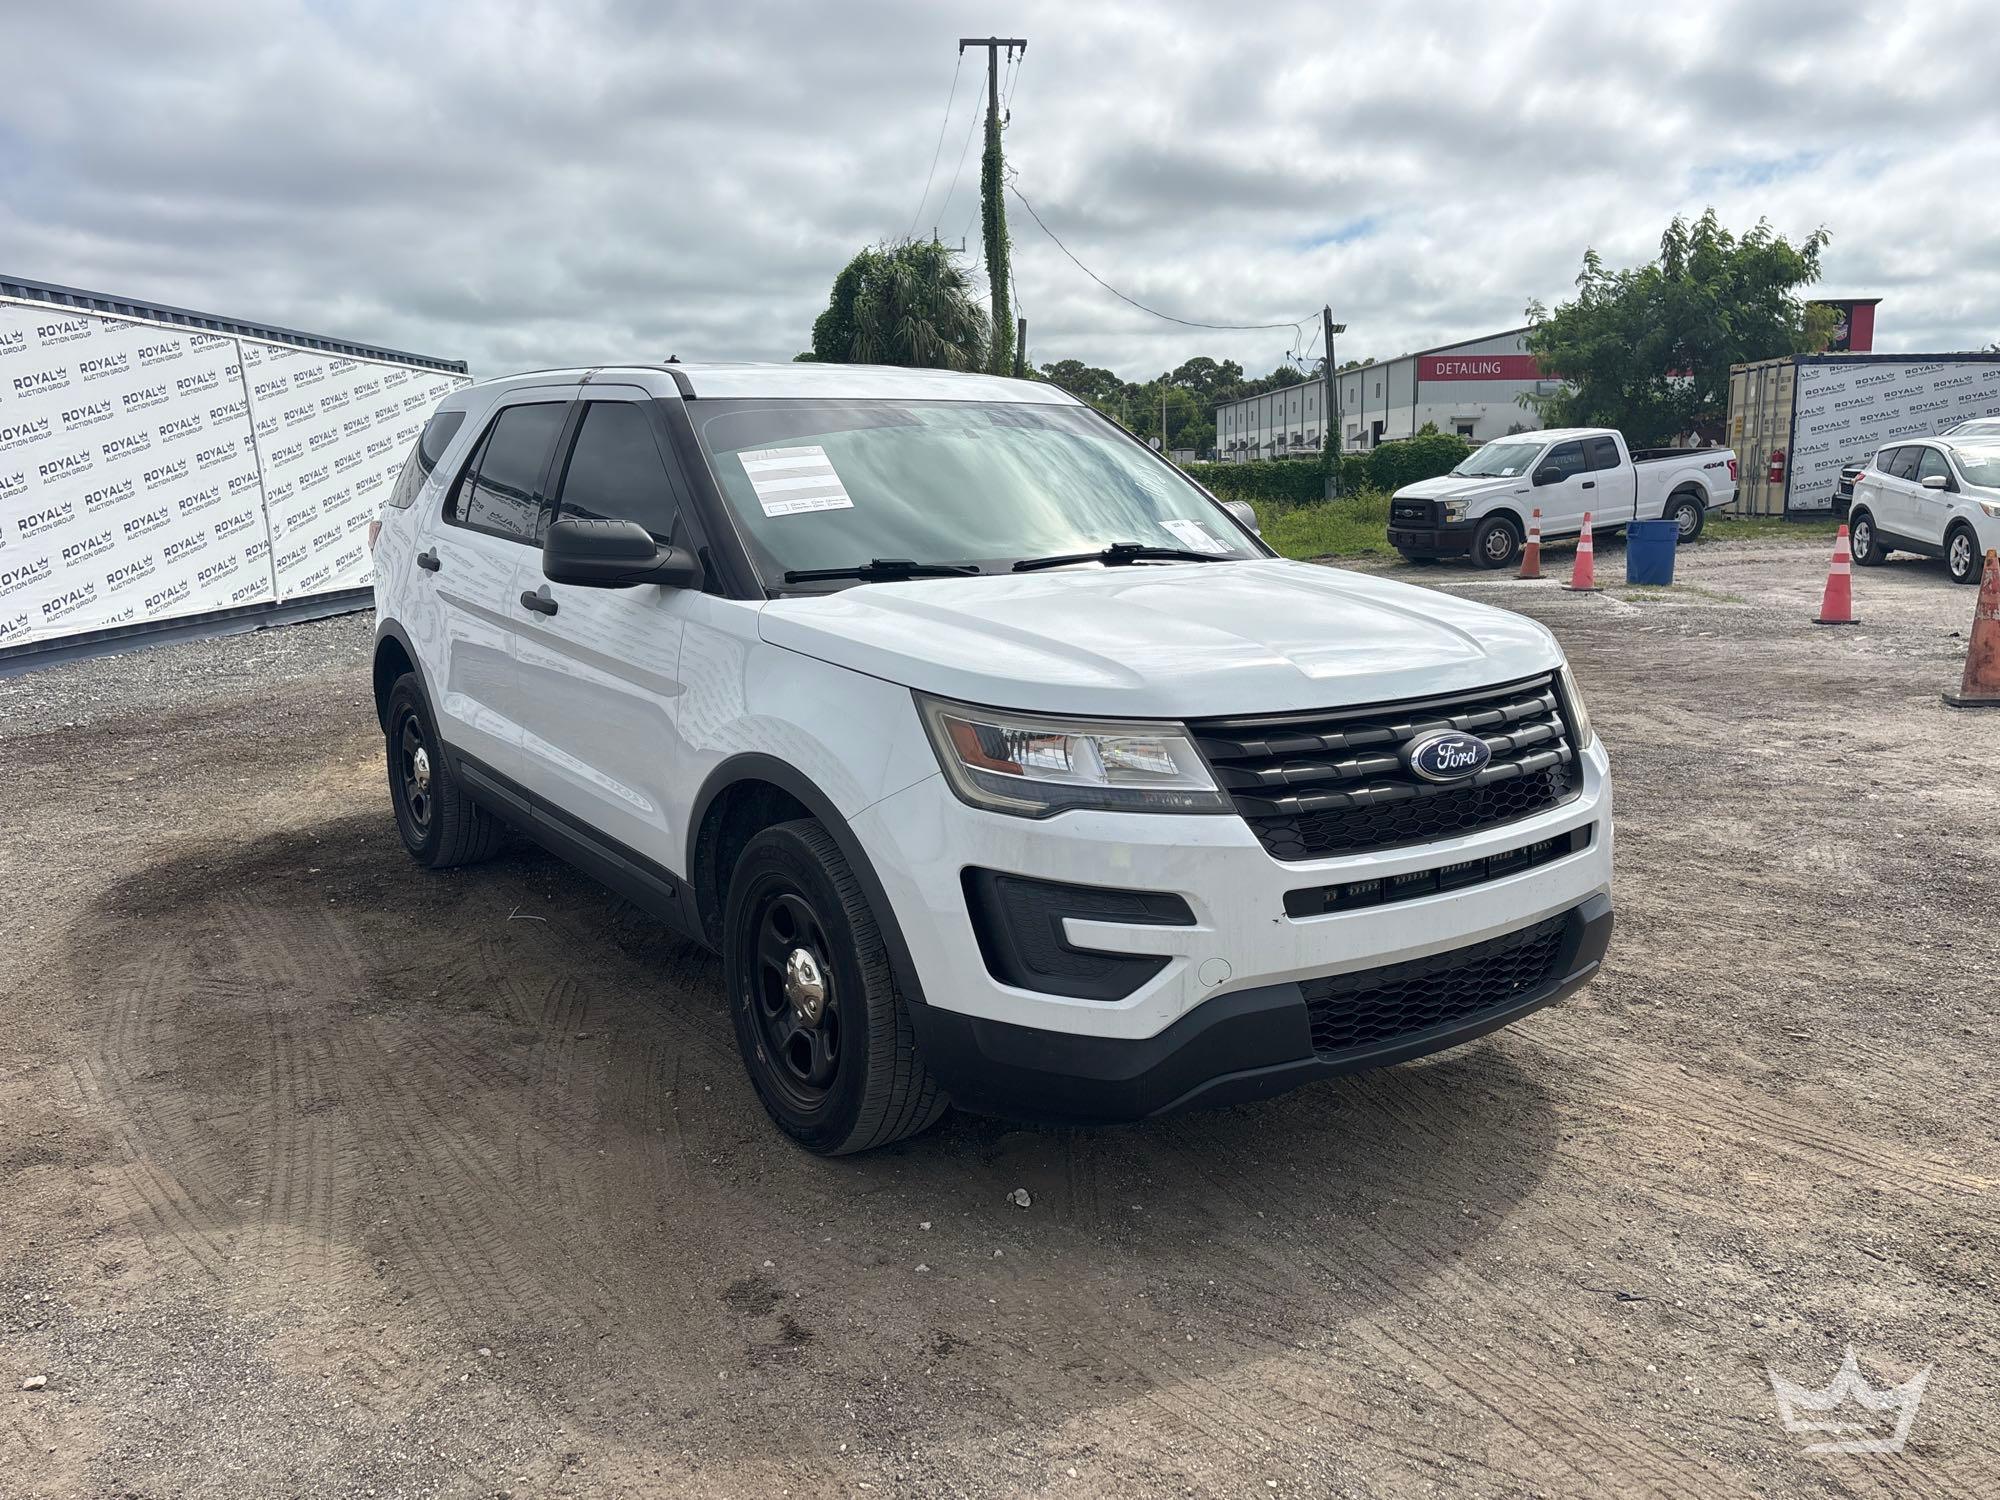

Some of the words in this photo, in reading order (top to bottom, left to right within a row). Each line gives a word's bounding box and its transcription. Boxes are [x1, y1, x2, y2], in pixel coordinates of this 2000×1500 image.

[37, 321, 80, 338] ROYAL
[105, 323, 129, 333] AUCTION
[41, 335, 71, 346] AUCTION
[70, 331, 92, 340] GROUP
[194, 344, 216, 353] AUCTION
[215, 339, 231, 348] GROUP
[3, 344, 27, 356] GROUP
[138, 342, 173, 359] ROYAL
[142, 356, 166, 366] AUCTION
[165, 351, 182, 360] GROUP
[79, 356, 119, 373] ROYAL
[84, 370, 111, 381] AUCTION
[110, 365, 130, 375] GROUP
[329, 358, 351, 371] ROYAL
[1436, 362, 1501, 375] DETAILING
[1905, 364, 1936, 374] ROYAL
[13, 370, 58, 390] ROYAL
[177, 373, 210, 390] ROYAL
[293, 368, 318, 382] ROYAL
[384, 371, 403, 384] ROYAL
[1856, 375, 1887, 385] ROYAL
[1933, 377, 1965, 388] ROYAL
[18, 386, 48, 398] AUCTION
[48, 380, 70, 390] GROUP
[180, 386, 203, 397] AUCTION
[202, 381, 218, 391] GROUP
[254, 379, 282, 394] ROYAL
[354, 382, 374, 395] ROYAL
[429, 384, 445, 396] ROYAL
[1806, 385, 1837, 396] ROYAL
[1884, 387, 1916, 398] ROYAL
[122, 387, 159, 405] ROYAL
[126, 401, 151, 413] AUCTION
[150, 395, 169, 406] GROUP
[320, 393, 343, 407] ROYAL
[403, 394, 421, 406] ROYAL
[1835, 398, 1866, 408] ROYAL
[1959, 391, 1990, 401] ROYAL
[61, 404, 103, 423] ROYAL
[210, 402, 240, 419] ROYAL
[284, 405, 309, 420] ROYAL
[375, 405, 394, 418] ROYAL
[1909, 401, 1941, 411] ROYAL
[66, 418, 94, 431] AUCTION
[93, 412, 114, 423] GROUP
[213, 415, 234, 426] AUCTION
[344, 417, 365, 431] ROYAL
[1860, 411, 1892, 421] ROYAL
[1937, 414, 1969, 424] ROYAL
[159, 418, 193, 436] ROYAL
[162, 431, 186, 443] AUCTION
[185, 425, 202, 435] GROUP
[256, 420, 271, 431] YAL
[396, 426, 414, 440] ROYAL
[1810, 422, 1842, 432] ROYAL
[1888, 424, 1920, 434] ROYAL
[29, 431, 52, 443] GROUP
[102, 435, 141, 455] ROYAL
[309, 430, 333, 445] ROYAL
[367, 438, 387, 453] ROYAL
[1839, 434, 1871, 444] ROYAL
[107, 449, 132, 462] AUCTION
[132, 442, 151, 454] GROUP
[196, 444, 228, 463] ROYAL
[271, 444, 297, 461] ROYAL
[1798, 444, 1821, 454] OYAL
[38, 454, 82, 476] ROYAL
[200, 458, 222, 470] AUCTION
[221, 451, 237, 462] GROUP
[334, 452, 356, 468] ROYAL
[1815, 457, 1846, 468] ROYAL
[43, 470, 72, 484] AUCTION
[72, 462, 93, 474] GROUP
[144, 463, 179, 483] ROYAL
[148, 477, 172, 490] AUCTION
[171, 470, 188, 481] GROUP
[228, 471, 258, 489] ROYAL
[299, 468, 323, 485] ROYAL
[232, 484, 252, 496] AUCTION
[356, 474, 377, 490] ROYAL
[3, 485, 28, 499] GROUP
[85, 483, 124, 505] ROYAL
[179, 490, 212, 510] ROYAL
[268, 486, 286, 500] OYAL
[322, 490, 345, 507] ROYAL
[89, 499, 116, 513] AUCTION
[115, 490, 135, 503] GROUP
[182, 504, 205, 516] AUCTION
[204, 496, 220, 507] GROUP
[18, 506, 63, 531] ROYAL
[23, 523, 53, 538] AUCTION
[53, 513, 75, 527] GROUP
[124, 511, 160, 533] ROYAL
[215, 514, 246, 534] ROYAL
[286, 508, 311, 526] ROYAL
[347, 511, 368, 527] ROYAL
[128, 526, 153, 540] AUCTION
[152, 517, 170, 530] GROUP
[218, 527, 239, 540] AUCTION
[238, 519, 254, 531] GROUP
[313, 528, 336, 546] ROYAL
[62, 536, 104, 560] ROYAL
[67, 552, 95, 567] AUCTION
[94, 542, 115, 555] GROUP
[164, 535, 198, 557] ROYAL
[167, 550, 190, 564] AUCTION
[190, 541, 207, 553] GROUP
[246, 540, 270, 558] ROYA
[248, 552, 267, 564] AUCTION
[276, 548, 302, 568] ROYAL
[336, 549, 358, 567] ROYAL
[0, 563, 38, 588] OYAL
[28, 570, 52, 585] GROUP
[106, 560, 145, 584] ROYAL
[111, 576, 136, 592] AUCTION
[136, 566, 155, 580] GROUP
[198, 560, 229, 581] ROYAL
[201, 574, 223, 588] AUCTION
[222, 565, 238, 577] GROUP
[300, 569, 324, 589] ROYAL
[145, 585, 180, 608] ROYAL
[231, 580, 261, 602] ROYAL
[42, 588, 86, 614] ROYAL
[47, 605, 76, 622] AUCTION
[76, 594, 97, 608] GROUP
[149, 600, 173, 615] AUCTION
[172, 590, 190, 603] GROUP
[6, 626, 32, 641] GROUP
[1437, 742, 1478, 769] Ford
